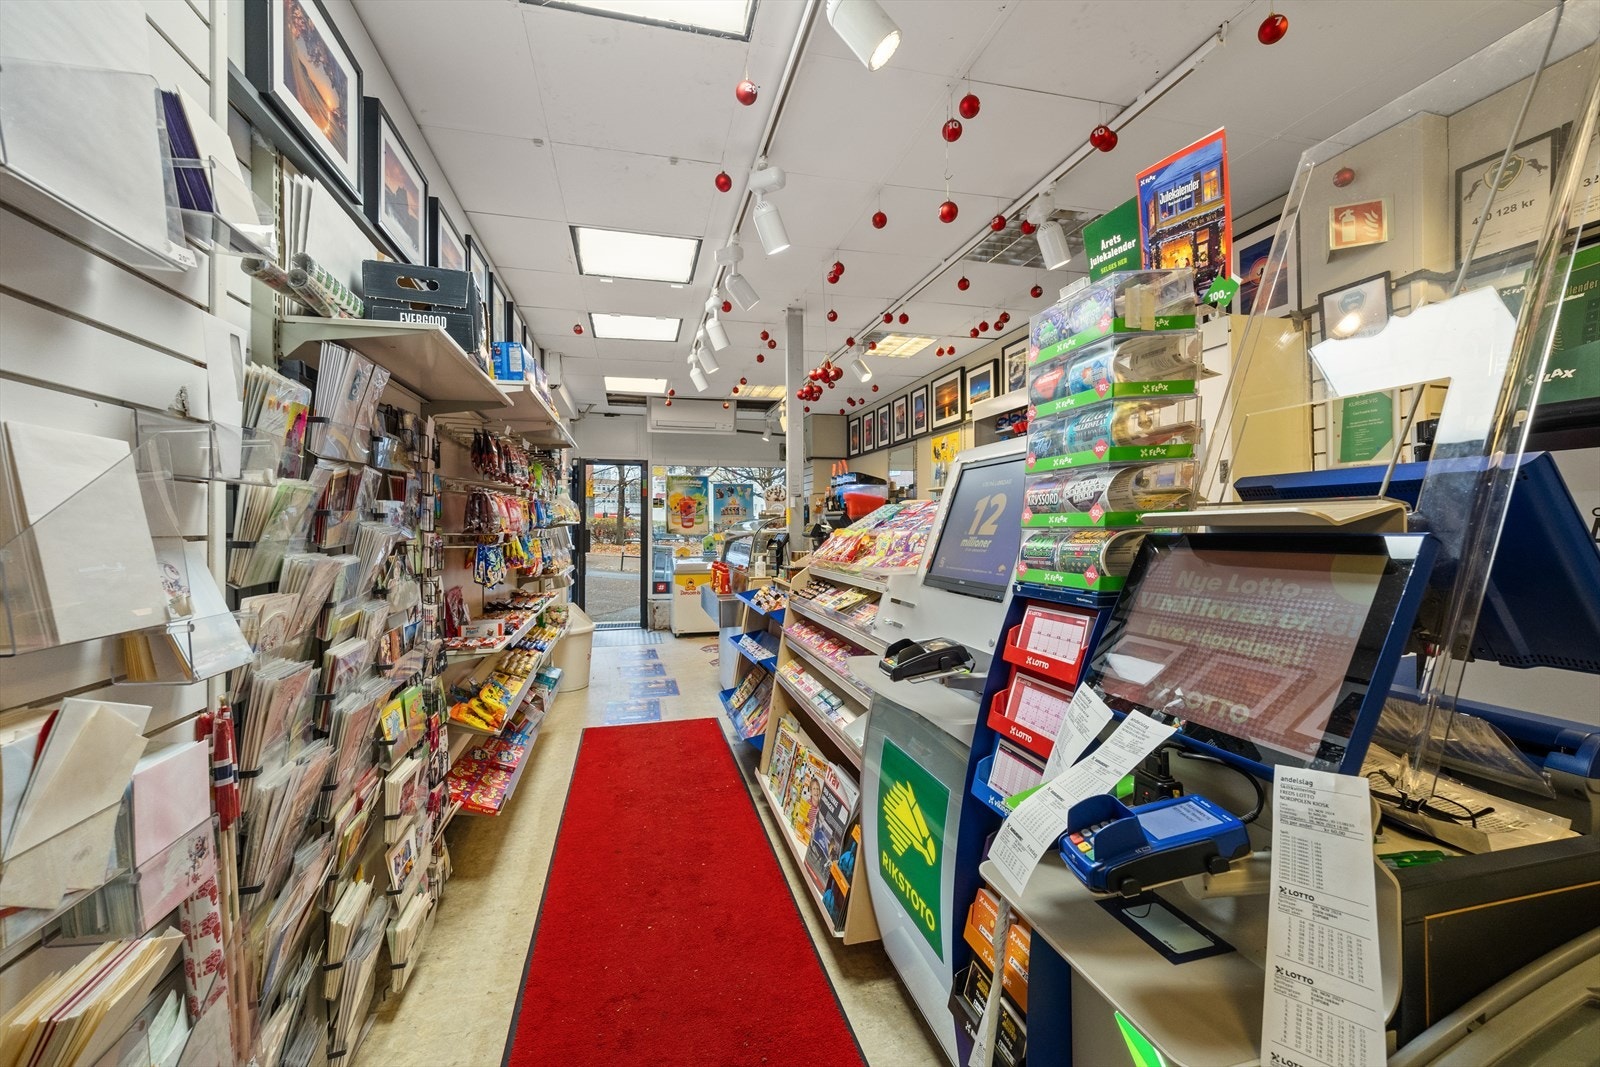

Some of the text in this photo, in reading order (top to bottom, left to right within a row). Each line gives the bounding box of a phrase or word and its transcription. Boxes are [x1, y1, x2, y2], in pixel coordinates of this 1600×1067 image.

[1273, 16, 1284, 26] 7
[947, 120, 960, 130] 10
[1093, 127, 1106, 137] 10
[1159, 179, 1200, 205] Julekalender
[1472, 199, 1535, 226] 40 128 kr
[1100, 257, 1128, 274] SELGES HER
[1512, 285, 1526, 294] FLA
[1209, 290, 1231, 302] 100,-
[400, 312, 447, 329] EVERGOOD
[1062, 338, 1077, 350] FLAX
[1151, 384, 1169, 392] FLAX
[1061, 398, 1075, 408] FLAX
[1149, 448, 1167, 456] FLAX
[1059, 456, 1073, 465] FLAX
[1027, 492, 1058, 506] KRYSSORD
[968, 493, 1007, 536] 12
[1055, 515, 1068, 523] FLAX
[960, 537, 993, 548] millioner
[1050, 574, 1064, 582] FLAX
[1177, 570, 1313, 596] Nye Lotto-
[1032, 659, 1049, 670] LOTTO
[1185, 691, 1250, 724] OTTO
[1016, 729, 1033, 743] LOTTO
[1280, 776, 1314, 787] andelslag
[1279, 789, 1315, 800] FREDS LOTTO
[1279, 795, 1312, 805] NORDPOLEN
[882, 850, 936, 932] RIKSTOTO
[1288, 889, 1315, 902] LOTTO
[1285, 970, 1314, 985] LOTTO
